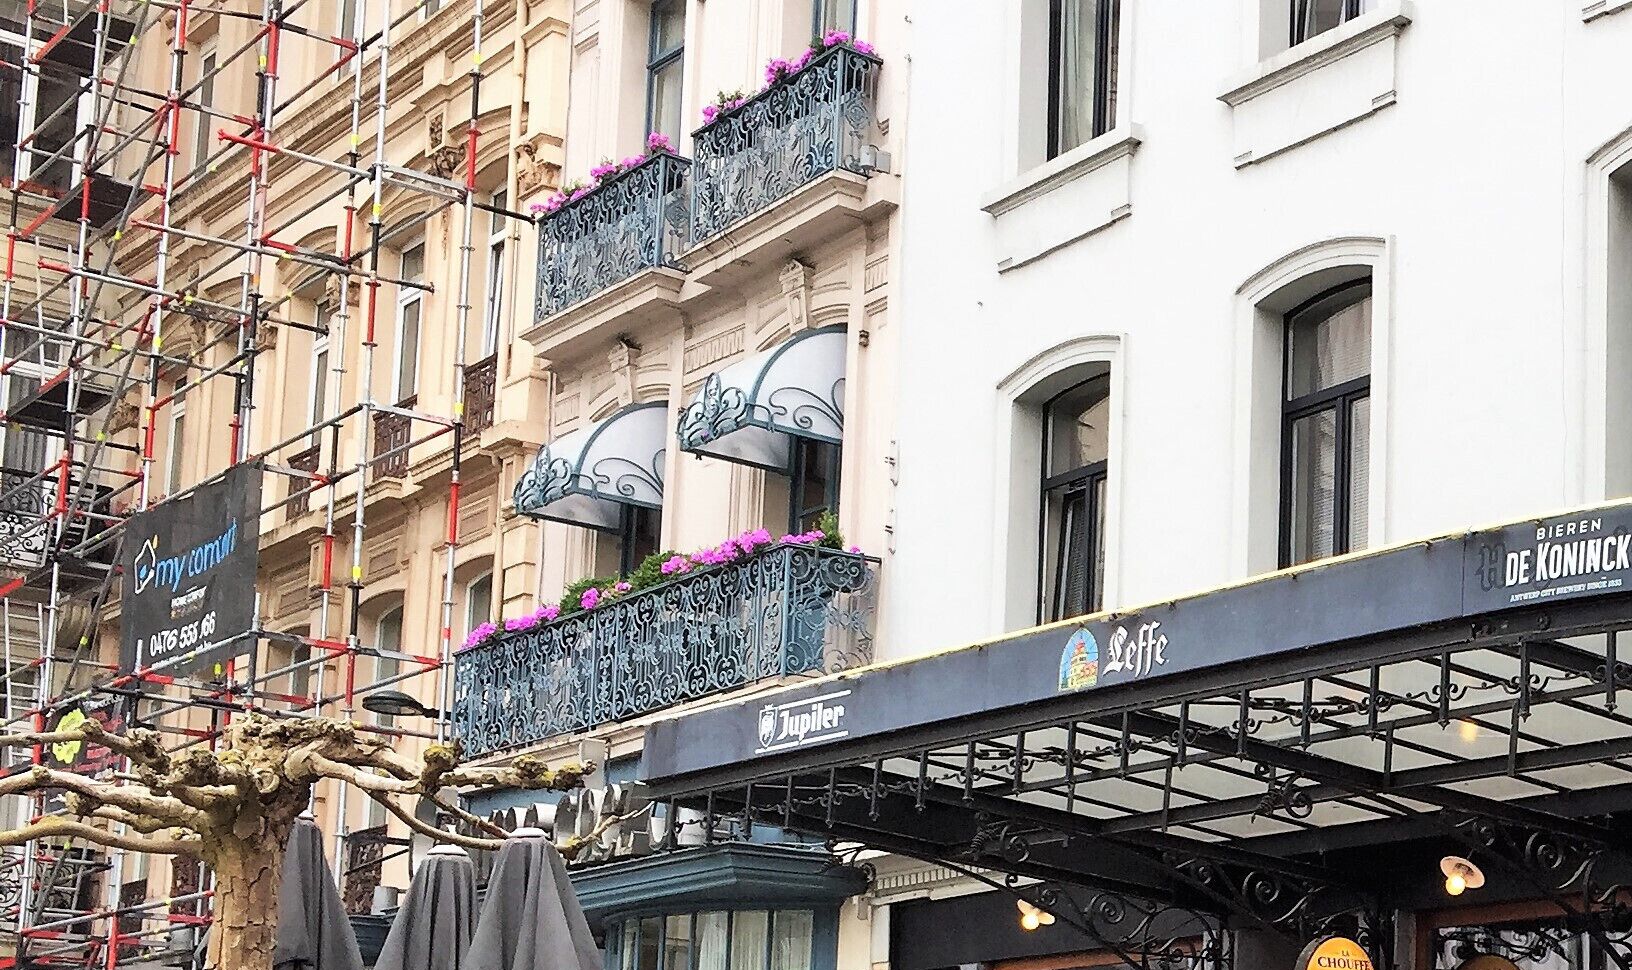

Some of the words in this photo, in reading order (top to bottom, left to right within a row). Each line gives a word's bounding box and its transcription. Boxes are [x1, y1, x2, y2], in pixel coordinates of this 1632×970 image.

[1536, 518, 1602, 540] BIEREN
[154, 554, 187, 593] my
[1505, 550, 1532, 587] DE
[1535, 534, 1632, 582] KONINCK
[149, 627, 179, 658] 0476
[1102, 620, 1170, 678] Leffe
[776, 701, 846, 743] Jupiler
[1317, 956, 1371, 970] CHOUFFE
